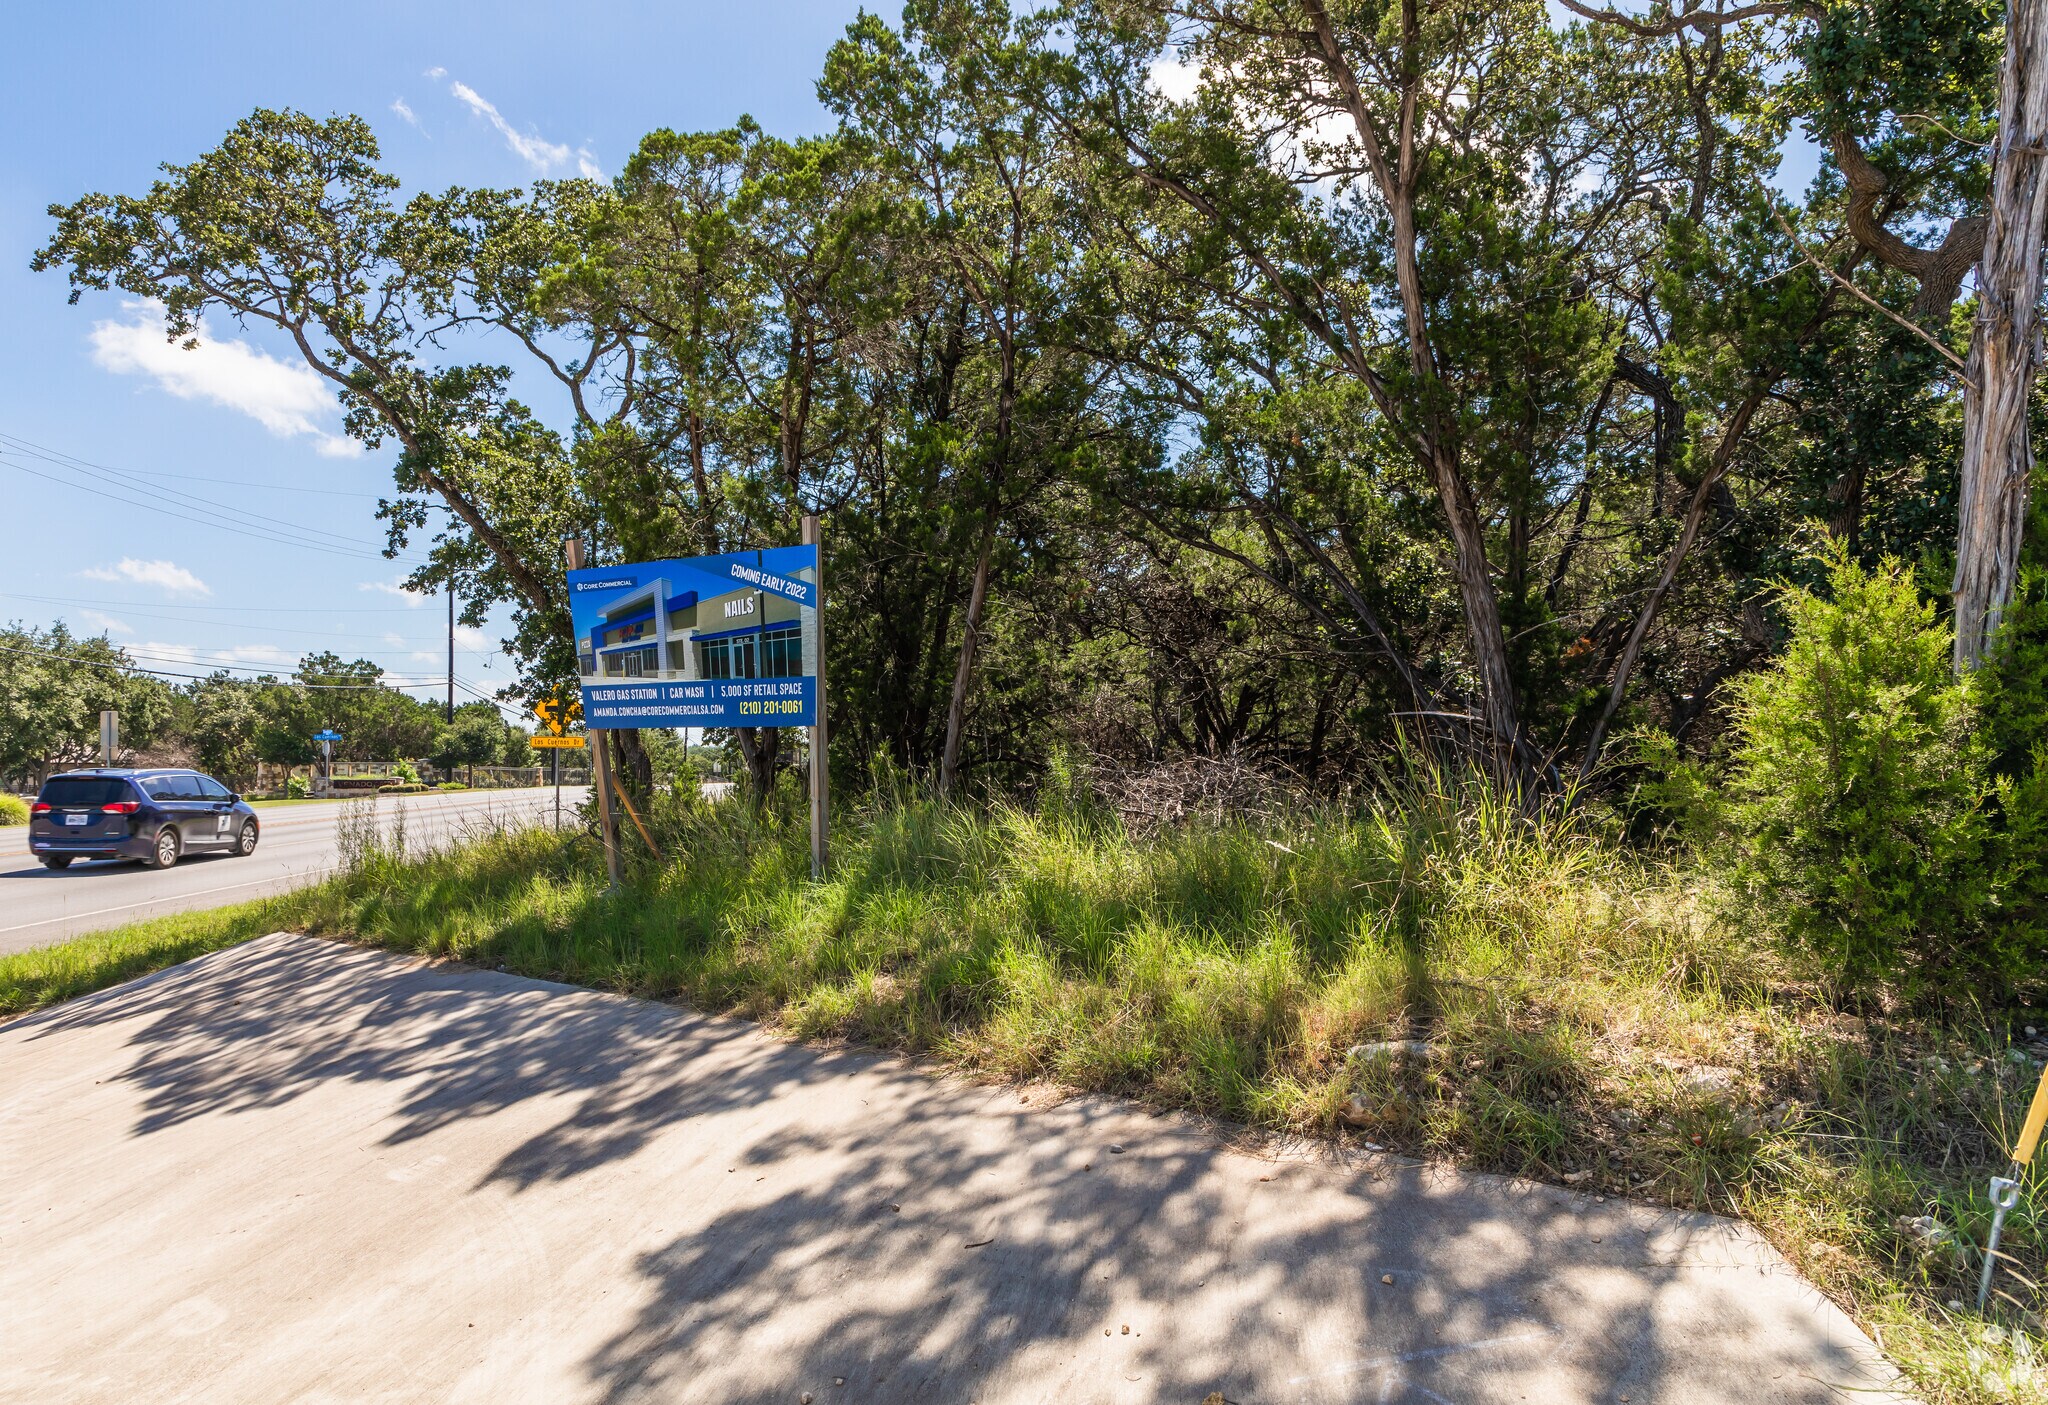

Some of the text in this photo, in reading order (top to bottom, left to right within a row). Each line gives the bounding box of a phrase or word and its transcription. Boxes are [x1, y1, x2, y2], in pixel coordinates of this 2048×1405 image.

[731, 564, 807, 599] COMING EARLY 2022
[724, 597, 755, 618] NAILS
[591, 683, 803, 701] VALERO GAS STATION CAR WASH 5,000 SF RETAIL SPACE
[593, 700, 803, 717] AMANDA.CONCHA@CORECOMMERCIALSA.COM (210) 201-0061
